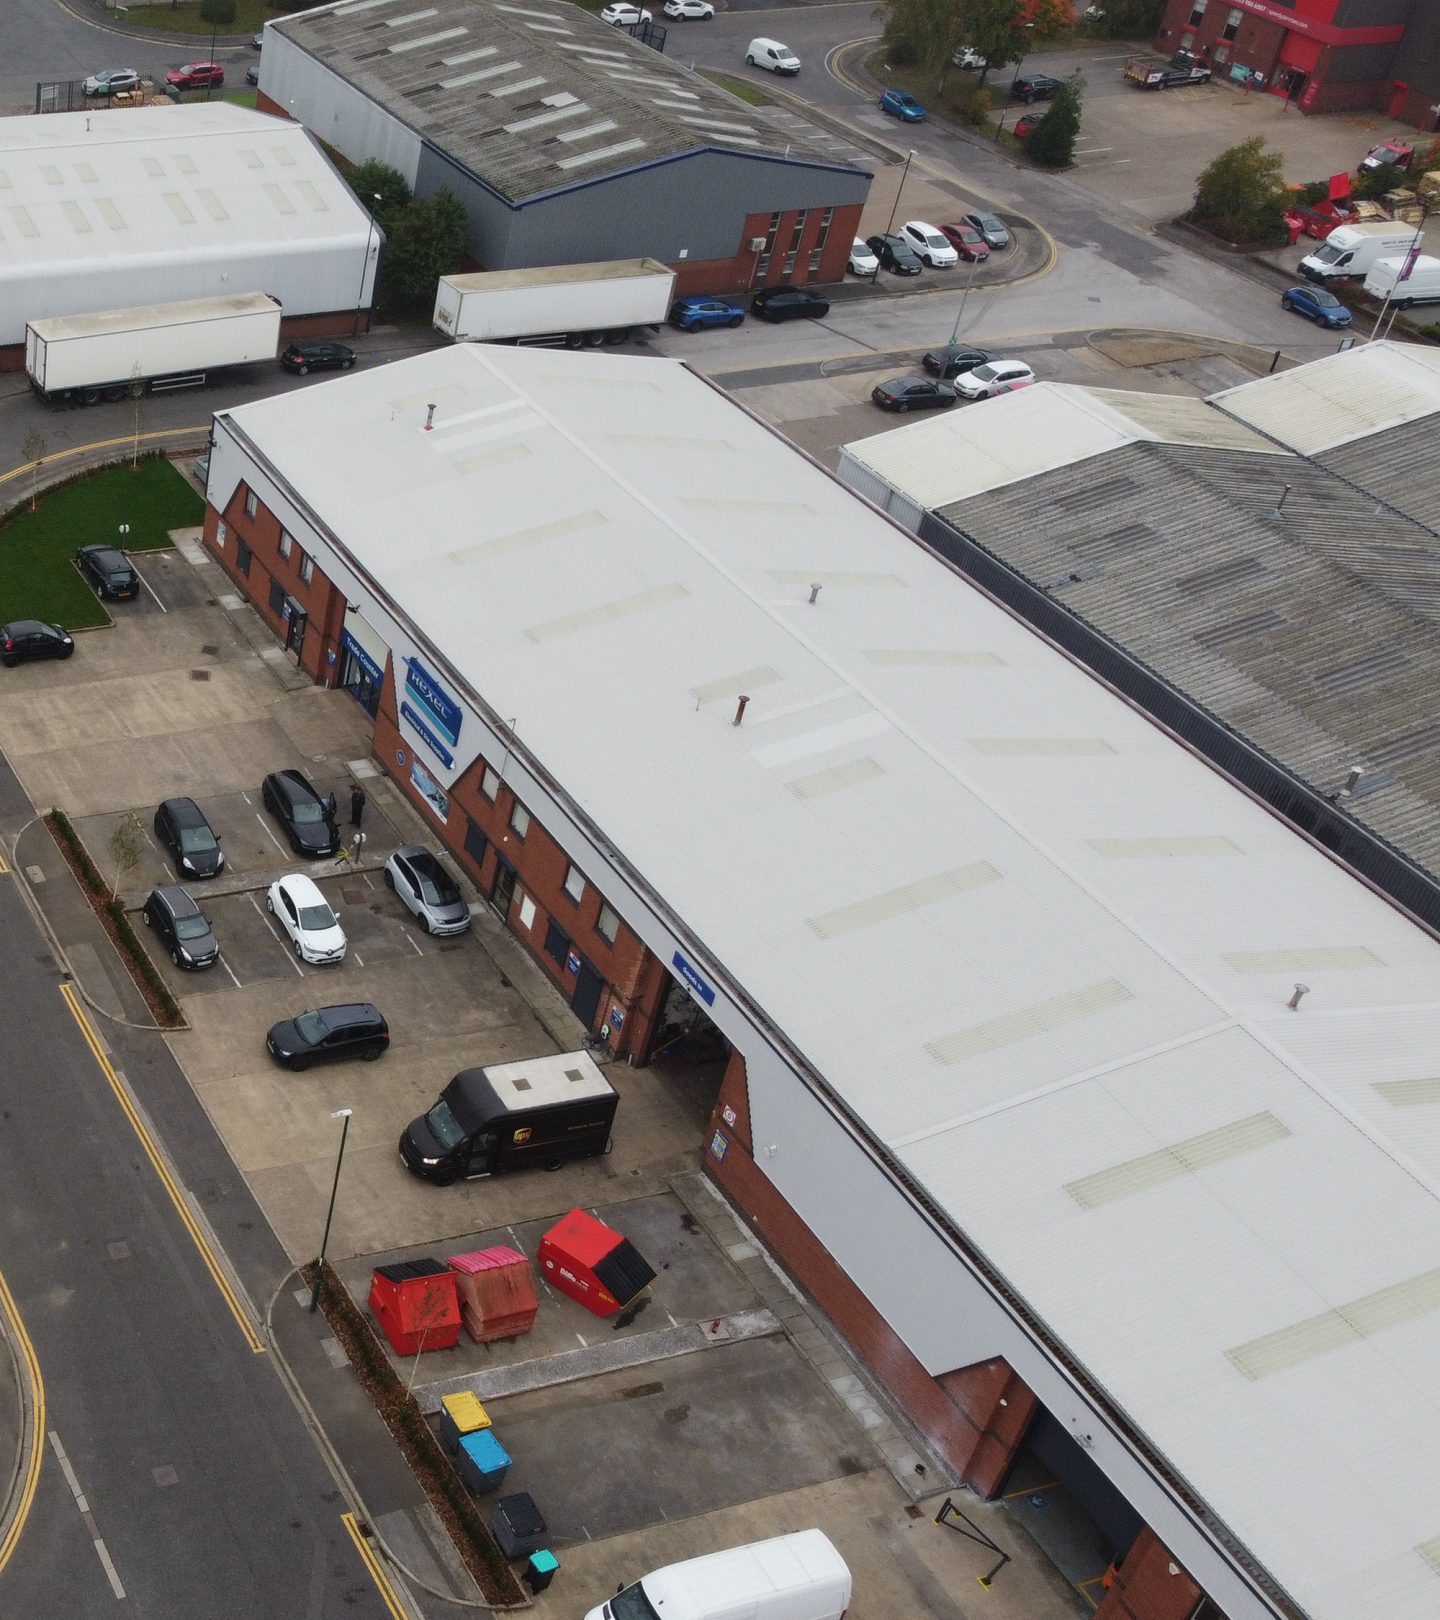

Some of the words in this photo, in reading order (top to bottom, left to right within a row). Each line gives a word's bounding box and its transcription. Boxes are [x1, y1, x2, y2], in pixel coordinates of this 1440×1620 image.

[346, 636, 360, 657] Trade
[360, 653, 379, 679] Counter
[682, 966, 697, 986] Goods
[559, 1267, 577, 1282] Biffa
